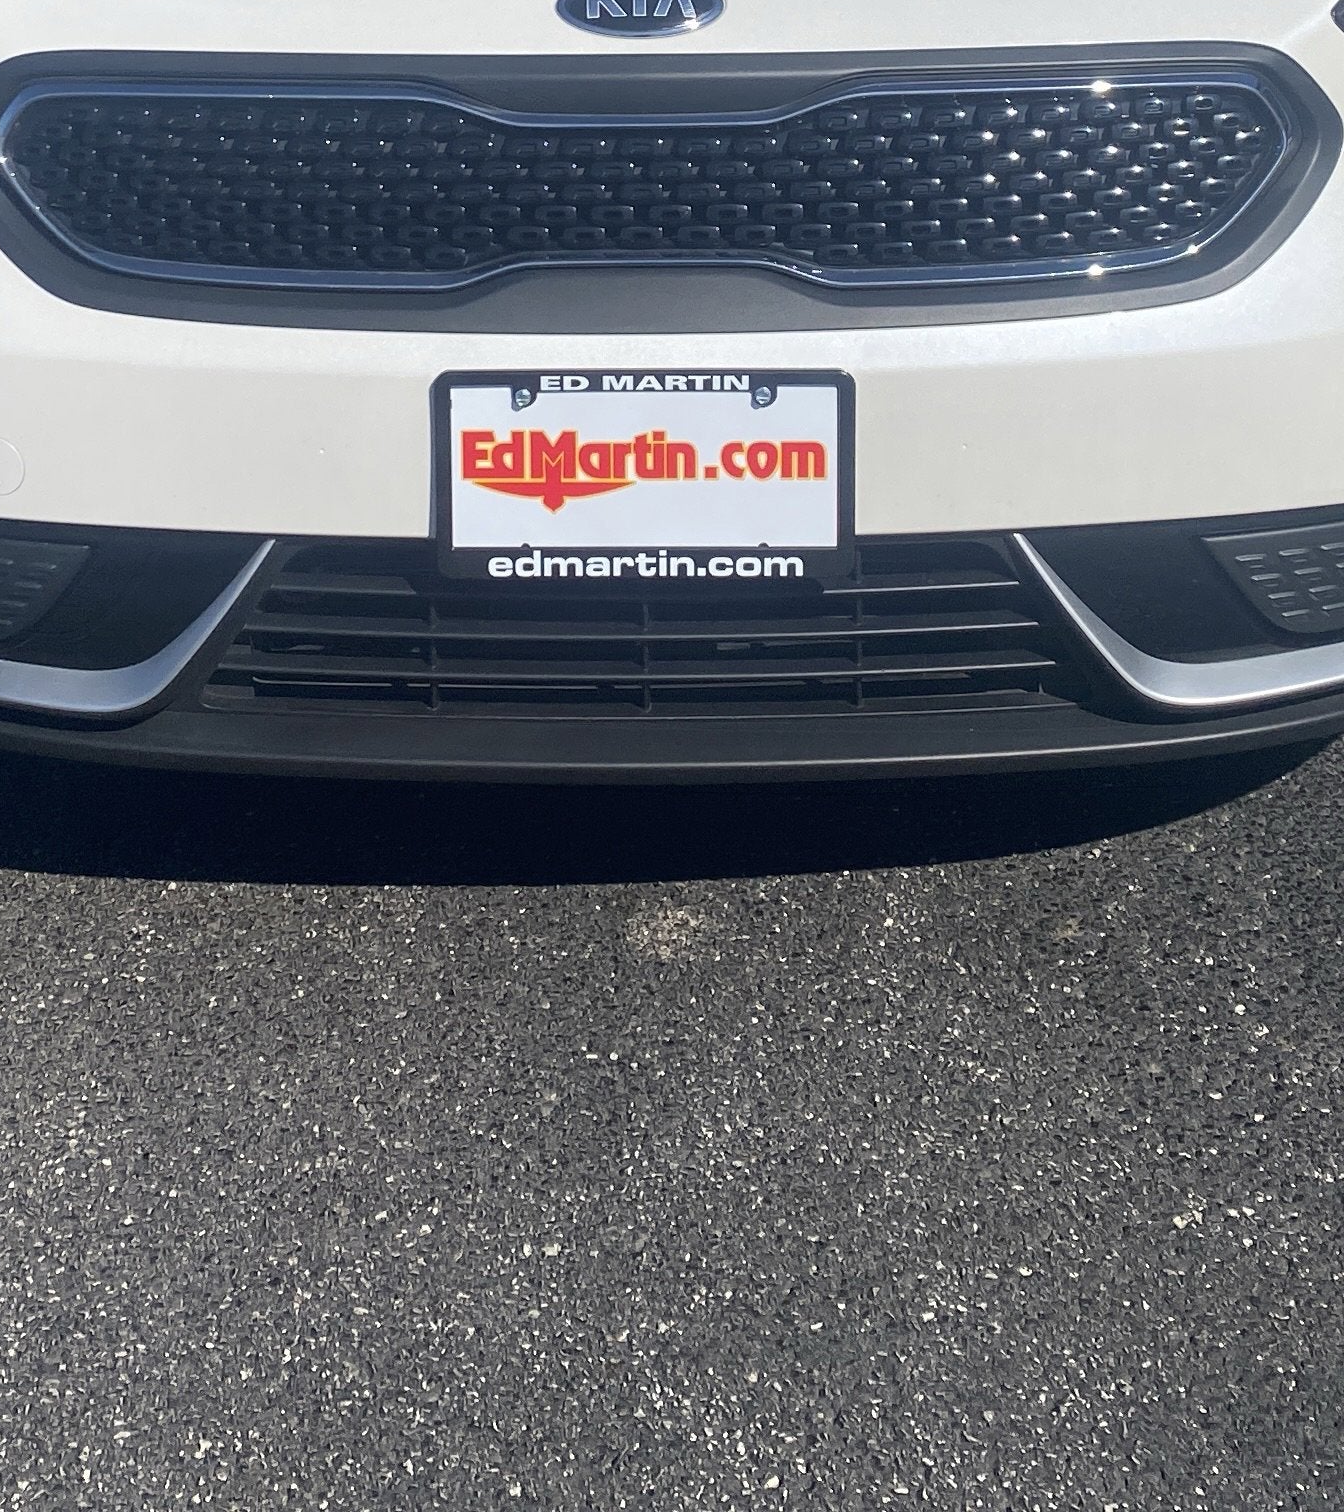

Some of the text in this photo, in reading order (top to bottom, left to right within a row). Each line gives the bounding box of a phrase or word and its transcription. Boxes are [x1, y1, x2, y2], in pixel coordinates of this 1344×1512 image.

[540, 375, 750, 391] ED MARTIN
[487, 549, 804, 579] edmartin.com
